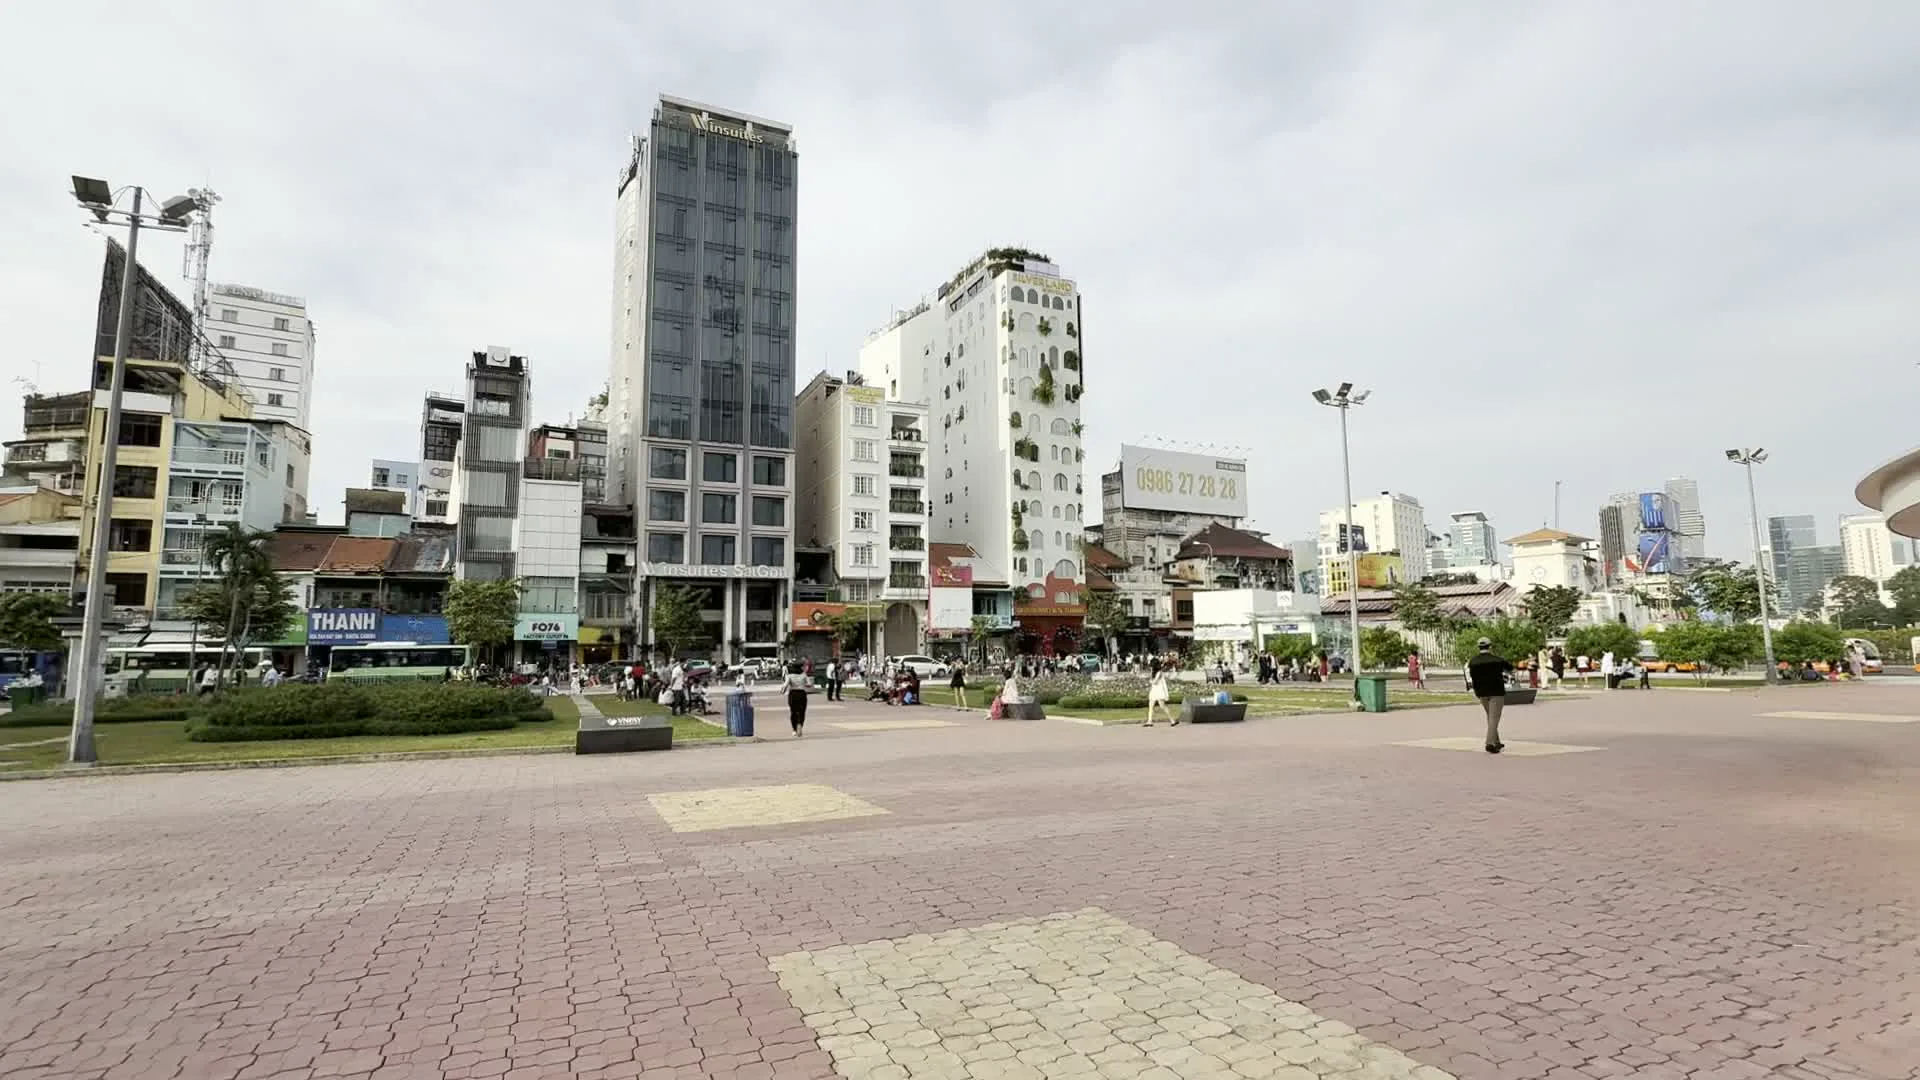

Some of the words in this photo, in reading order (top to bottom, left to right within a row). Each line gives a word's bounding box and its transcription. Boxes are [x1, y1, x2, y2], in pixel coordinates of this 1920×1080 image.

[690, 112, 763, 144] Winsuites
[1137, 466, 1174, 494] 0986
[1178, 470, 1194, 496] 27
[1198, 473, 1216, 498] 28
[1219, 477, 1237, 500] 28
[311, 612, 376, 631] THANH
[531, 622, 561, 632] FO76
